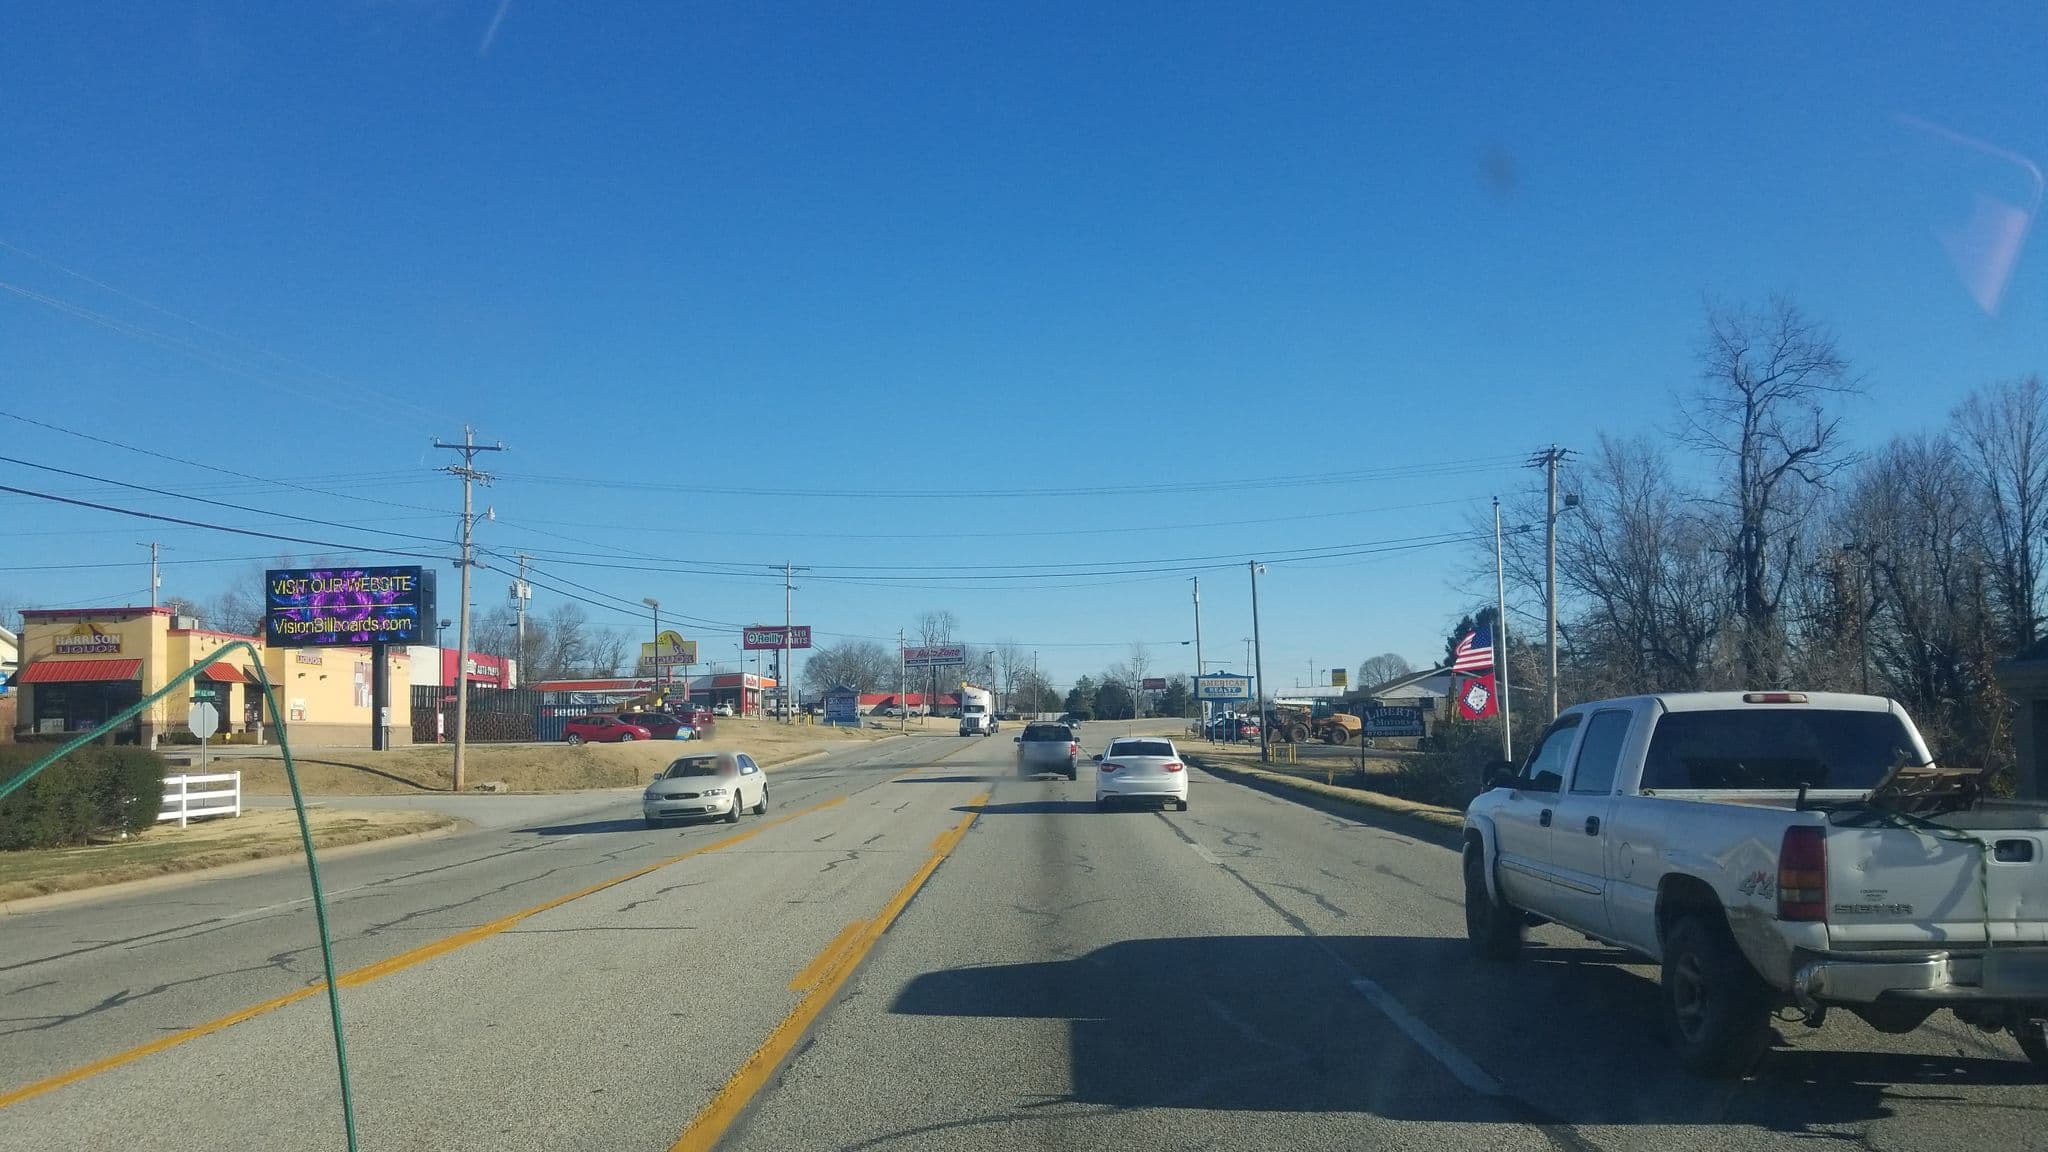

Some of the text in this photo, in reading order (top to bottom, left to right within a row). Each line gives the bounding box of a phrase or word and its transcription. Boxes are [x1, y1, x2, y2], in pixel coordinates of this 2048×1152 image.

[273, 576, 412, 595] VISIT OUR WEBSITE
[274, 616, 412, 635] VisionBillboards.com
[56, 634, 120, 646] HARRISON
[747, 631, 784, 645] O'Reilly
[58, 645, 118, 654] LIQUOR
[1200, 679, 1246, 687] AMERICAN
[1365, 707, 1420, 720] LIBERTY
